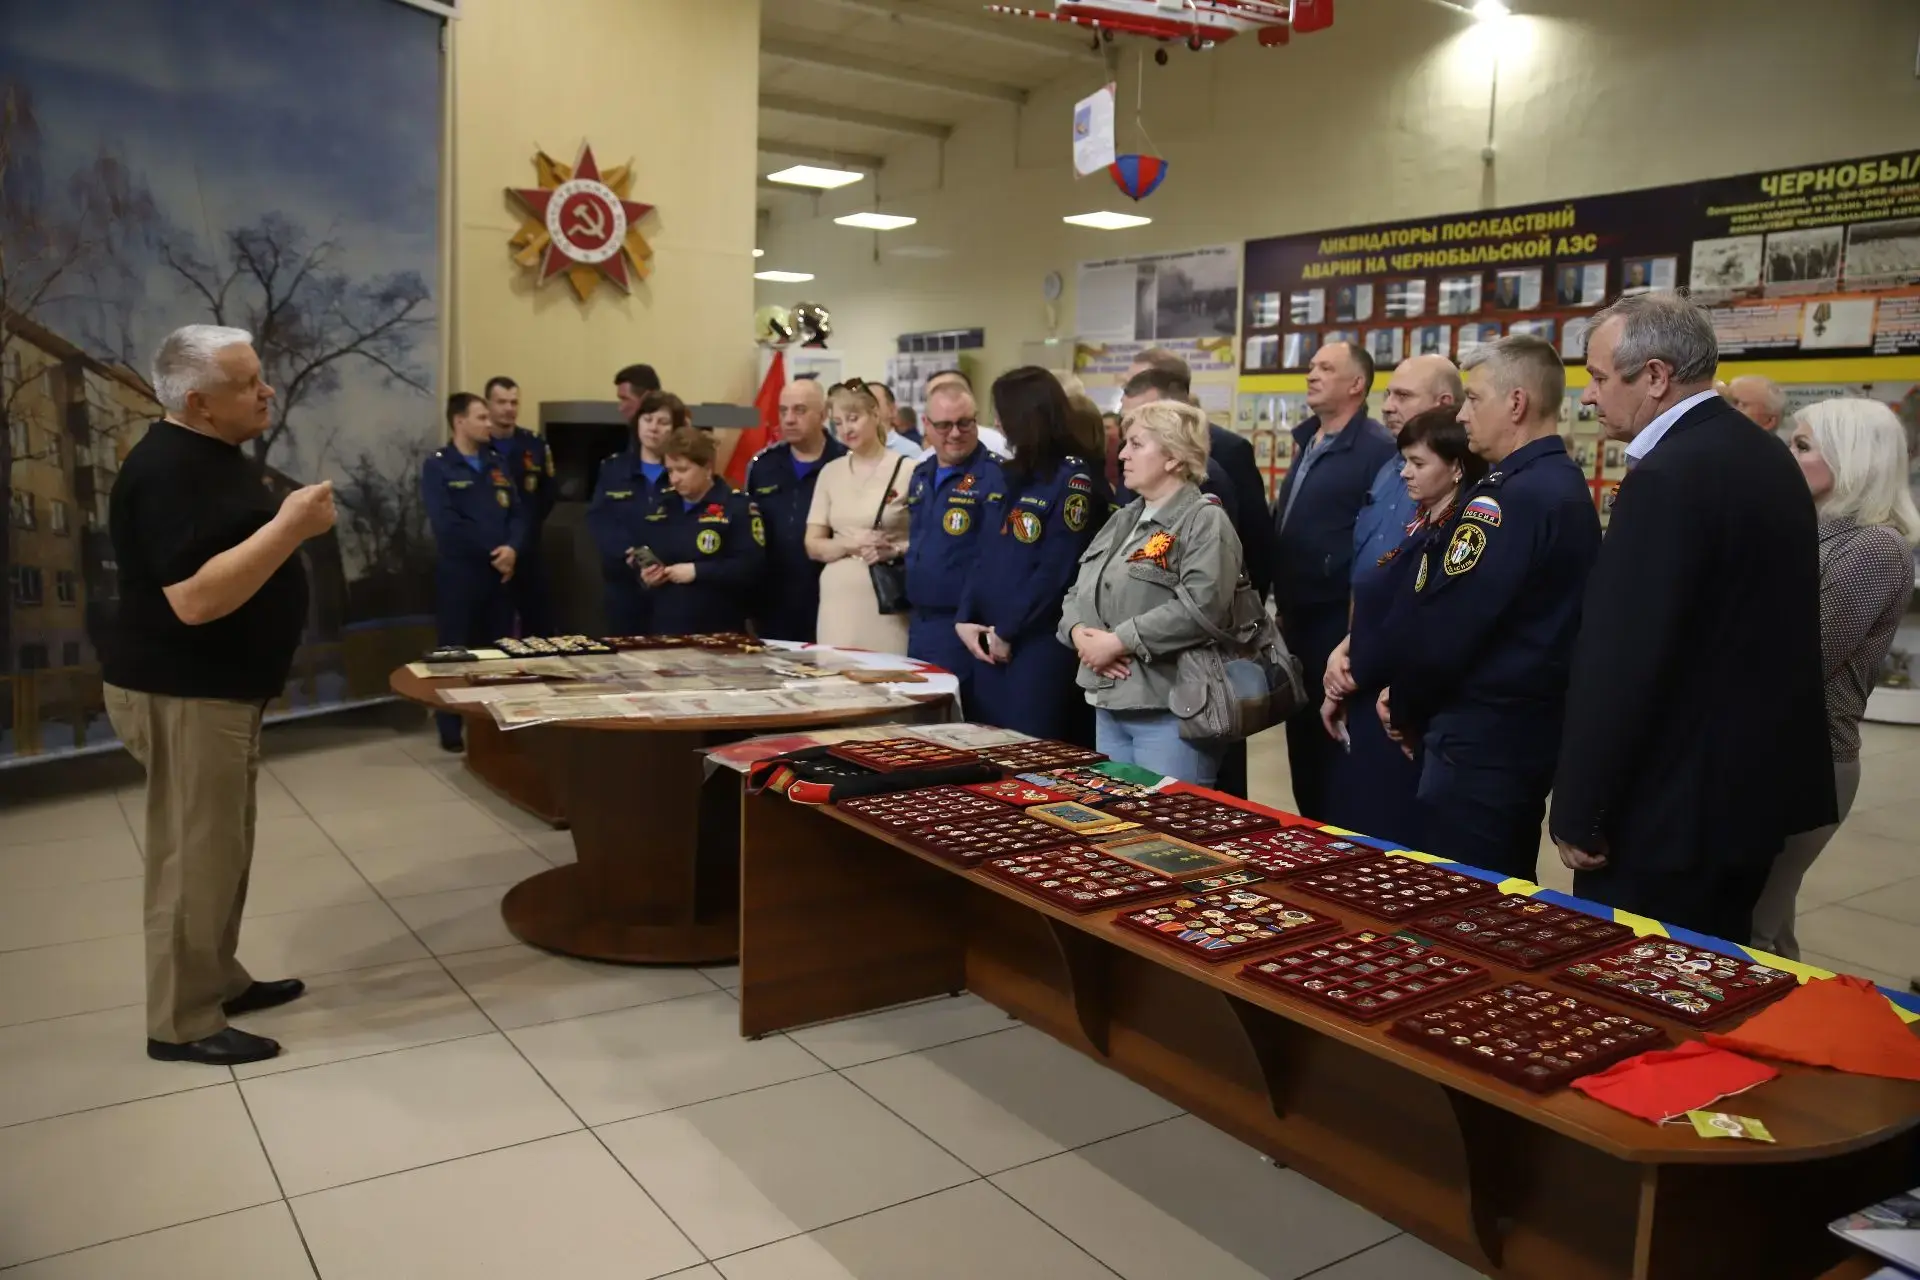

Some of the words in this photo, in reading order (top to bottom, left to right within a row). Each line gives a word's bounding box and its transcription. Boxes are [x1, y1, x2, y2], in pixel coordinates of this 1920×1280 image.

[1318, 226, 1437, 254] ЛИКВИДАТОРЫ
[1441, 205, 1575, 239] ПОСЛЕДСТВИЙ
[1301, 258, 1362, 280] АВАРИИ
[1364, 255, 1387, 273] НА
[1390, 233, 1551, 271] ЧЕРНОБЫЛЬСКОЙ
[1555, 233, 1598, 256] АЭС
[1465, 510, 1495, 523] РОССИЯ
